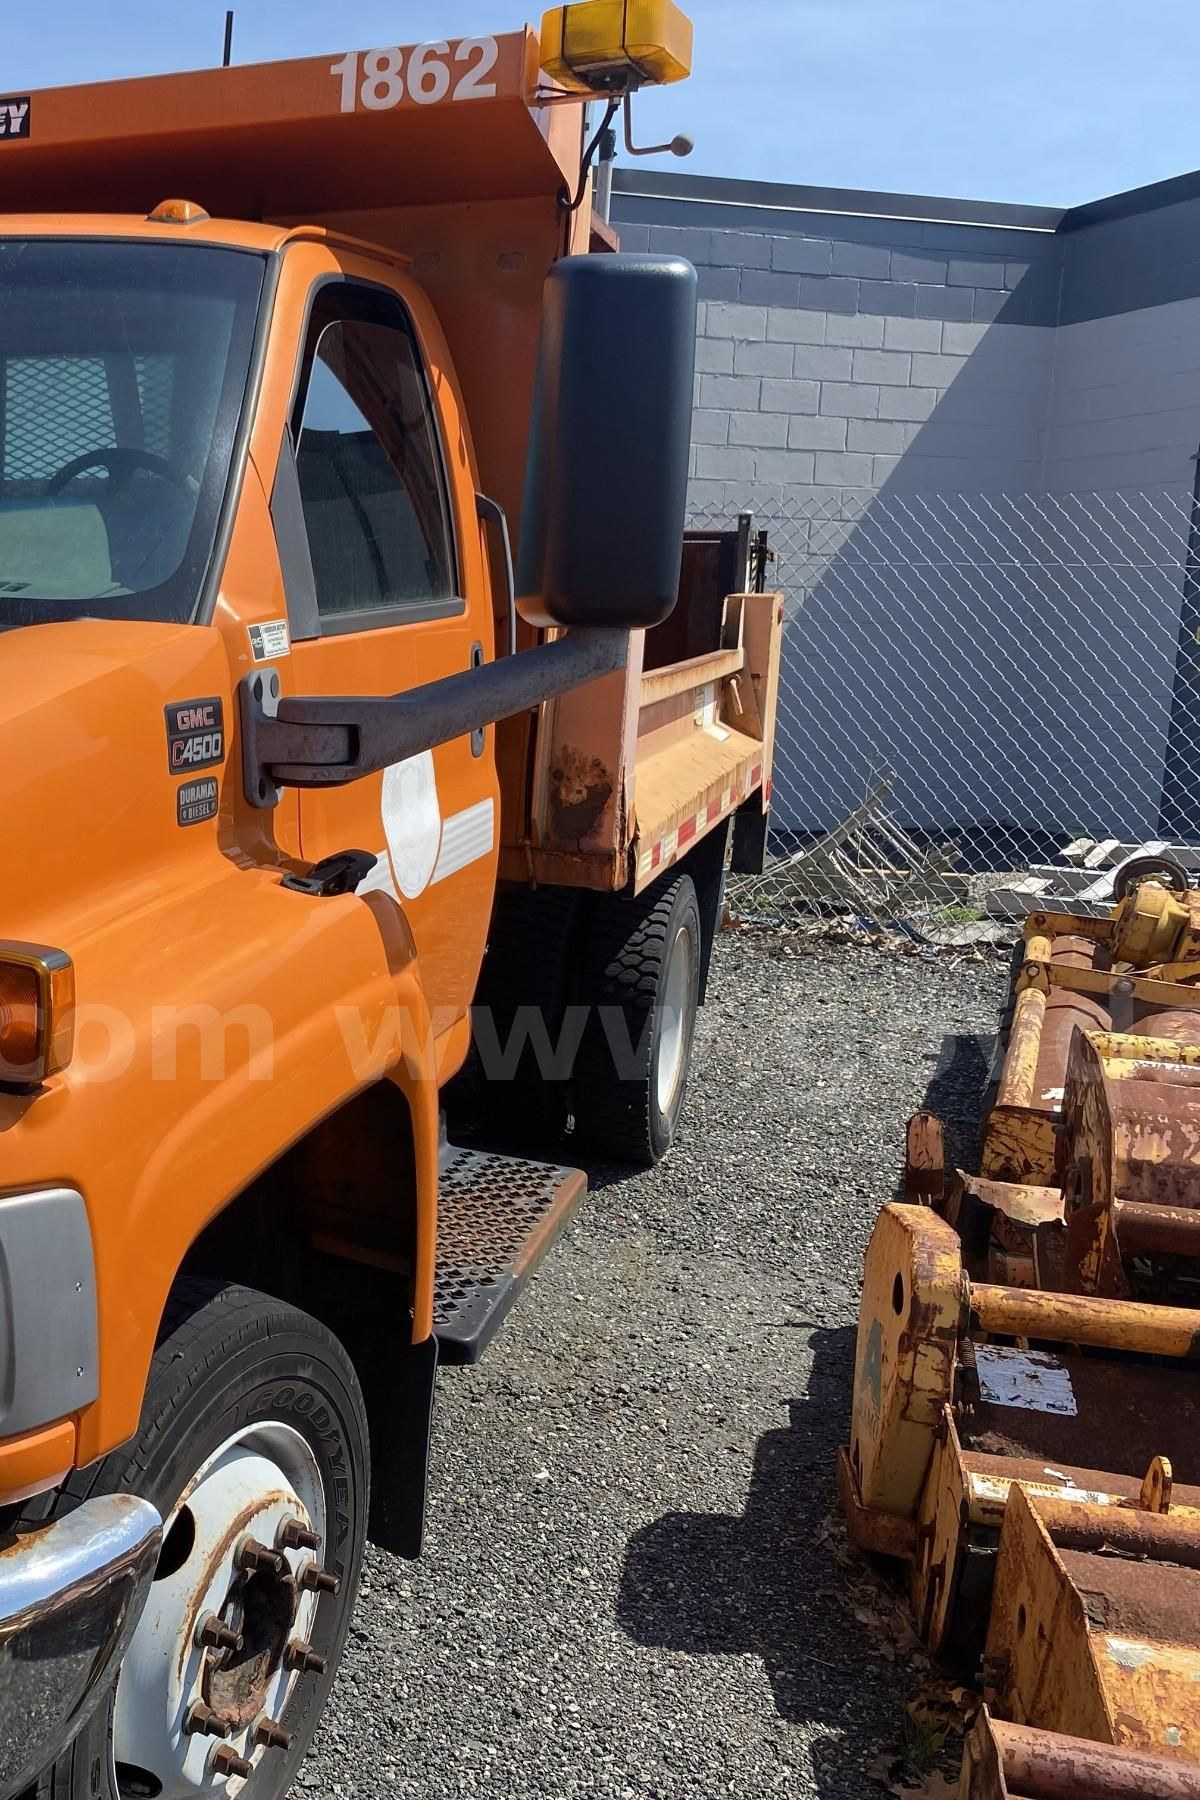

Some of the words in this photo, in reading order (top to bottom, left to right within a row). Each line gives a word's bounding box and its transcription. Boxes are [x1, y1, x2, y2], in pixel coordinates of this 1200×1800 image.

[330, 36, 499, 113] 1862
[176, 705, 215, 731] GMC
[172, 732, 222, 766] C4500
[180, 781, 217, 806] DURAMAX
[188, 802, 210, 819] DIESEL
